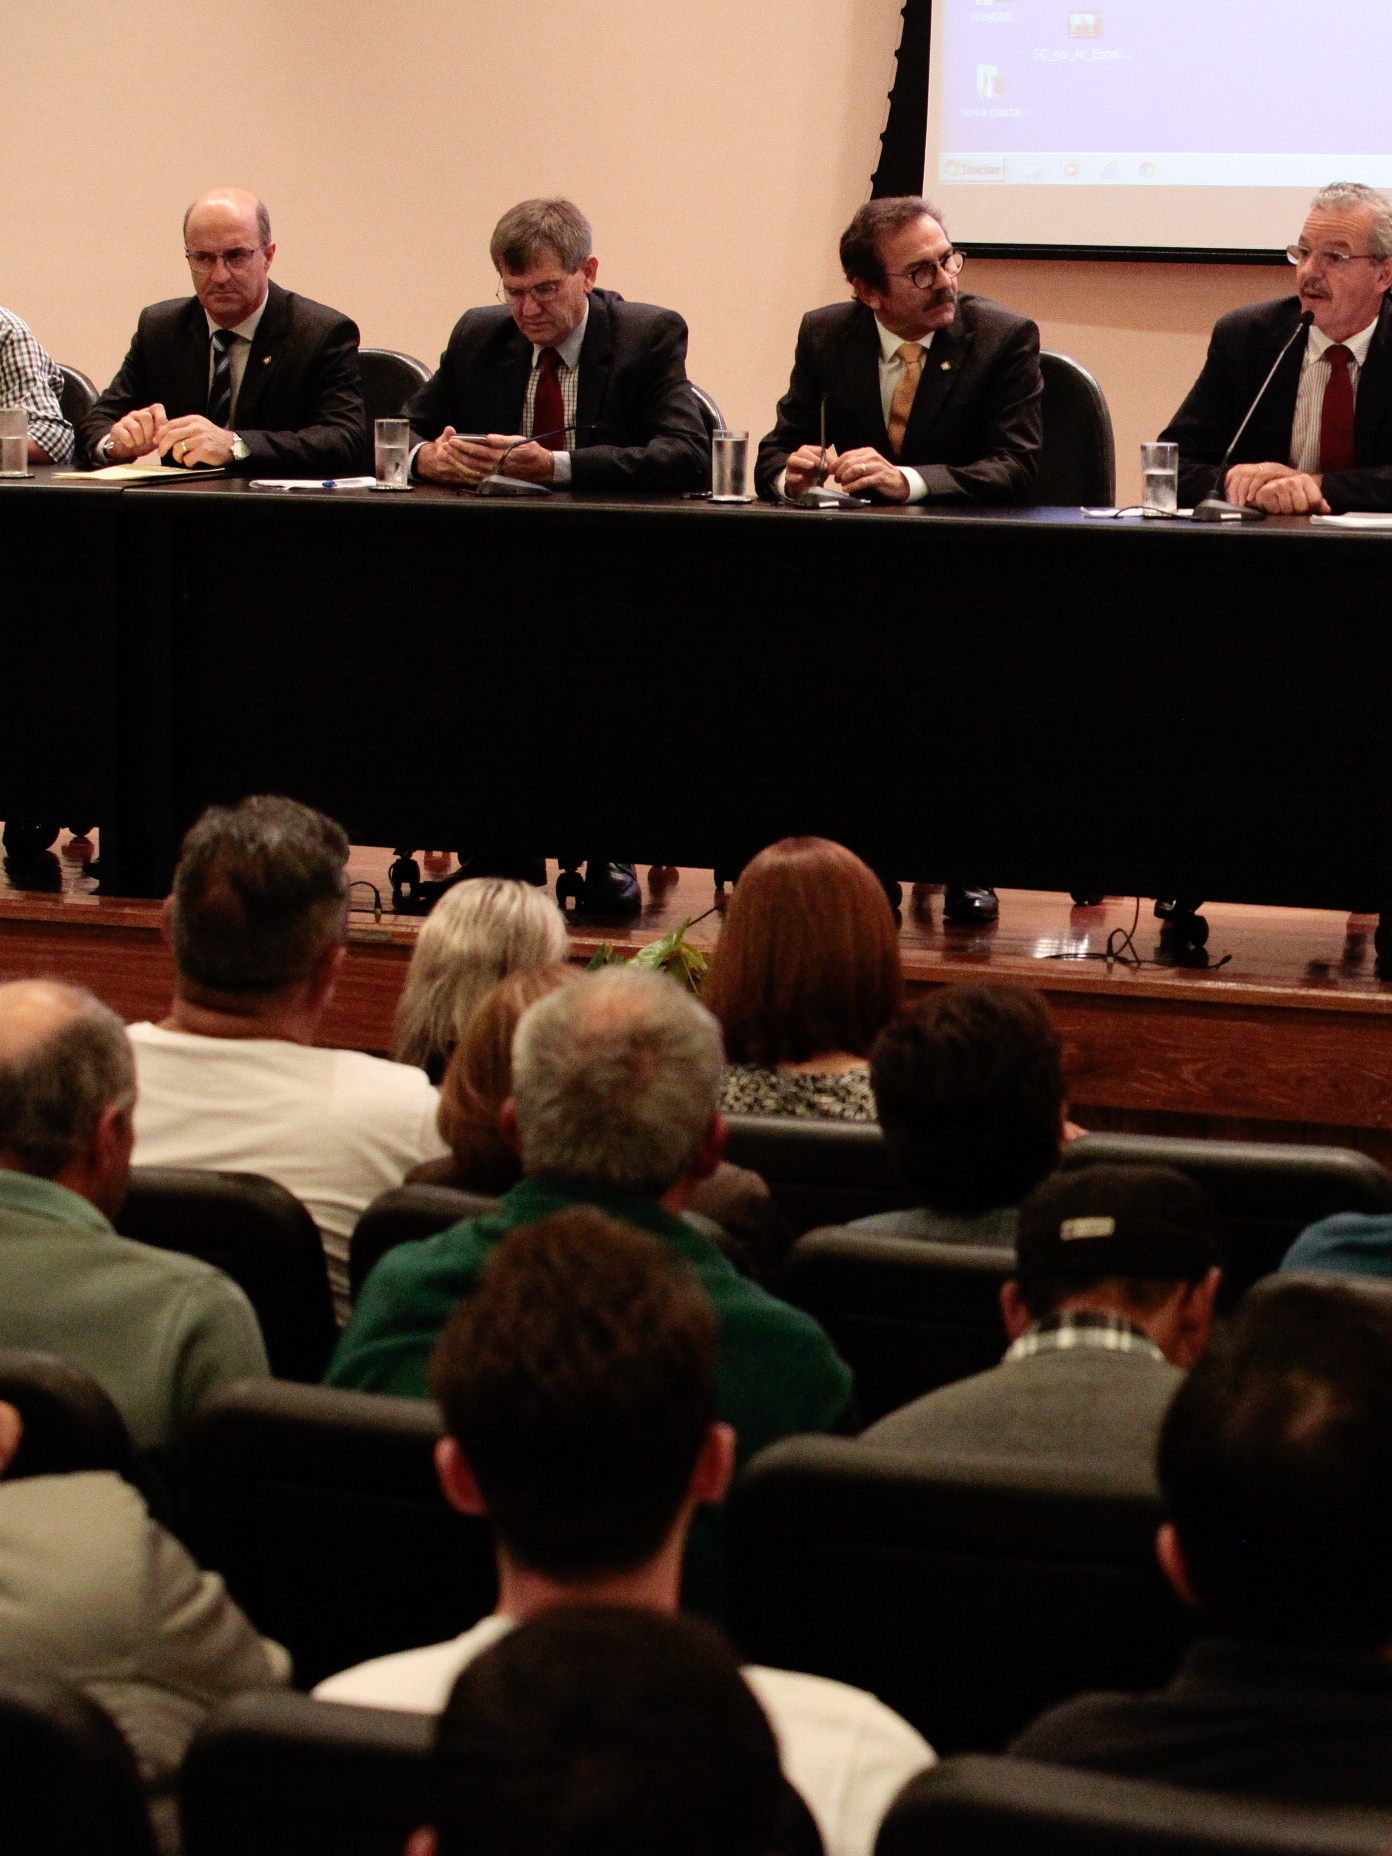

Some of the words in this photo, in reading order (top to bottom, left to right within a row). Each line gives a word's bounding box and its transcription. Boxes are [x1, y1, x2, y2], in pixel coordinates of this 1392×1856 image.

[970, 12, 1013, 22] WinRAR
[960, 107, 987, 117] Nova
[990, 108, 1021, 119] pasta
[963, 163, 1001, 175] Iniciar
